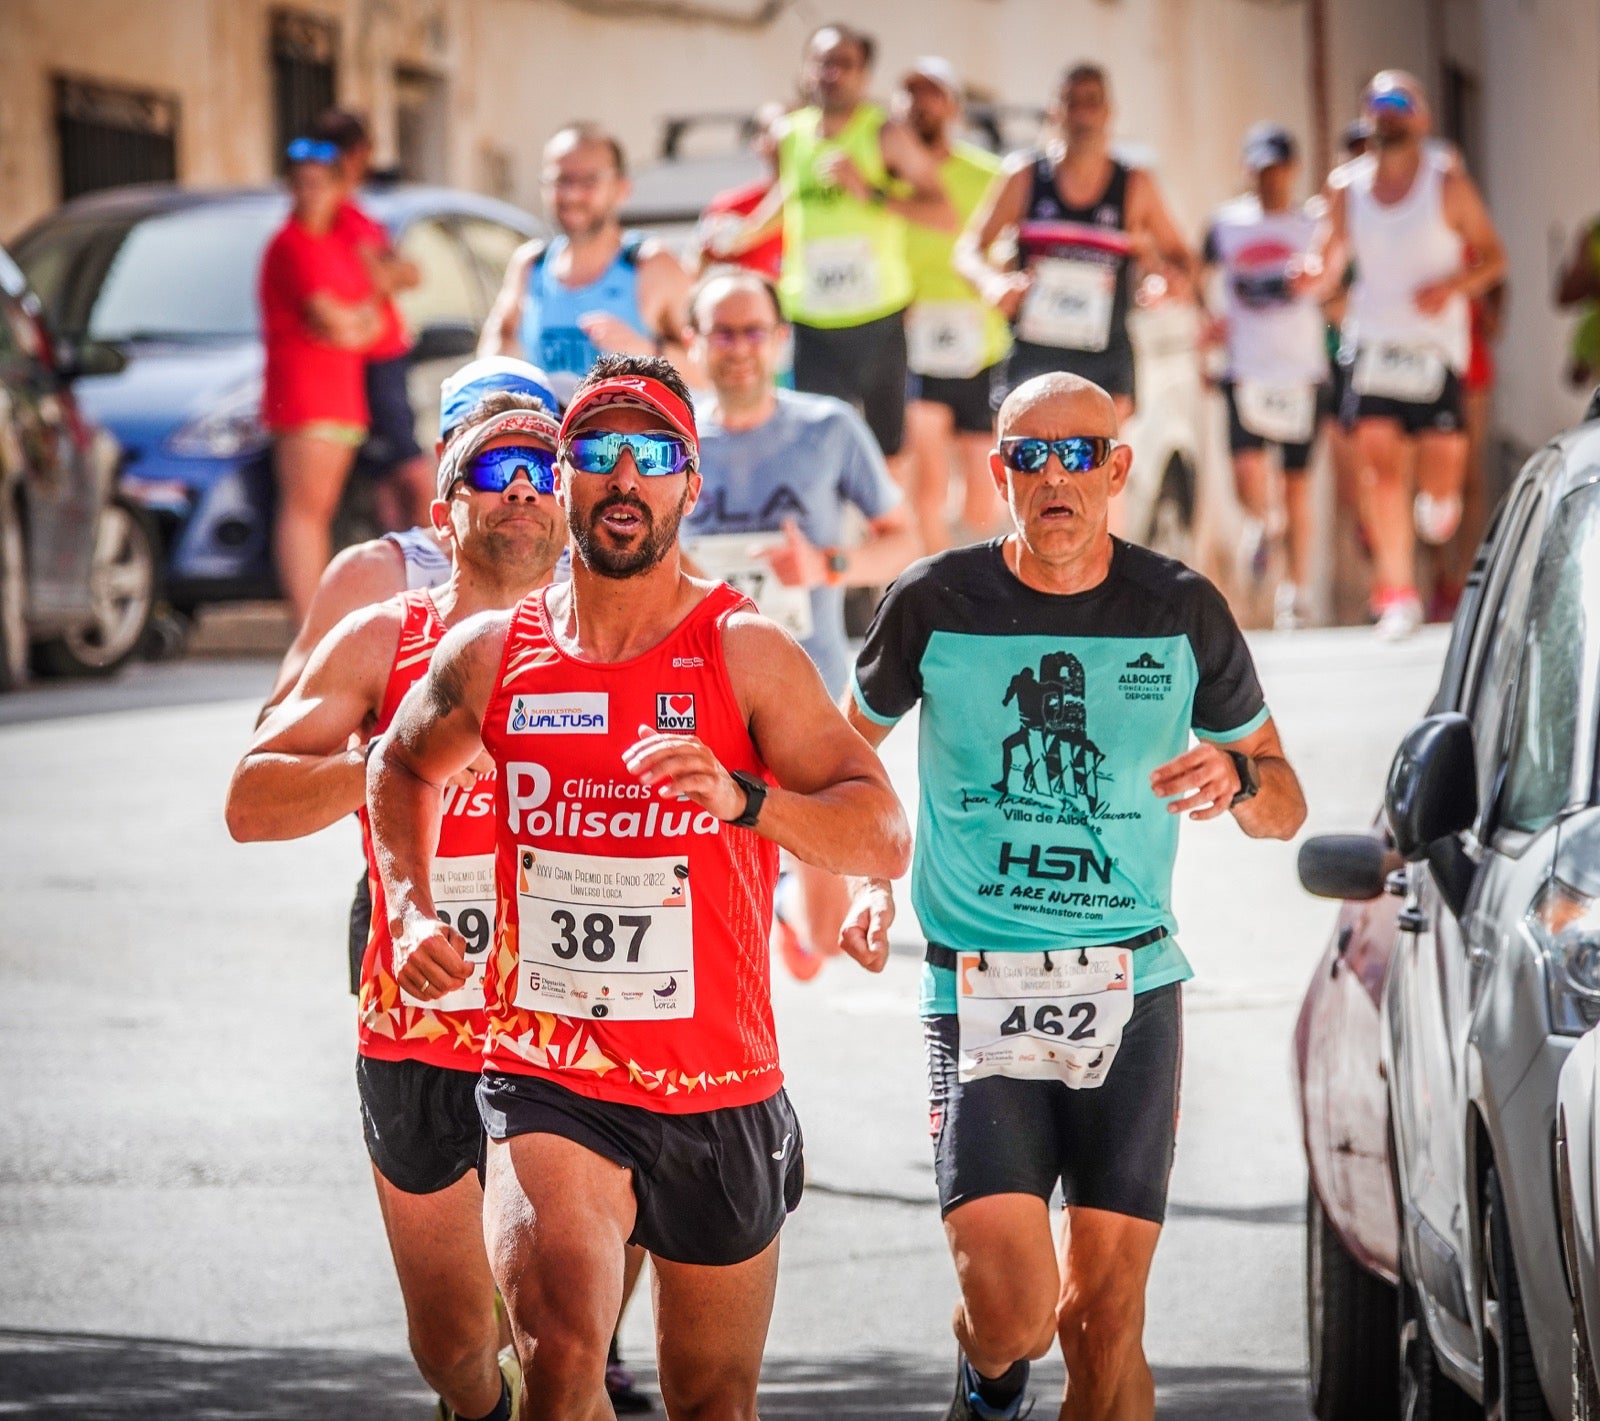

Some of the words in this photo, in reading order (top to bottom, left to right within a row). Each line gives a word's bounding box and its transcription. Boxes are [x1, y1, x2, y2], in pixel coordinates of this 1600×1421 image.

[1118, 674, 1172, 684] ALBOLOTE
[1125, 692, 1165, 700] DEPORTES
[660, 696, 667, 716] I
[658, 716, 695, 728] MOVE
[563, 778, 652, 800] Clínicas
[1003, 808, 1032, 823] Villa
[1036, 812, 1053, 824] de
[999, 842, 1113, 885] HSN
[643, 873, 666, 887] 2022
[978, 884, 1005, 897] WE
[1010, 885, 1046, 900] ARE
[1048, 890, 1137, 910] NUTRITION!
[1013, 902, 1104, 921] www.hsnstore.com
[551, 909, 652, 963] 387
[1000, 1001, 1097, 1041] 462
